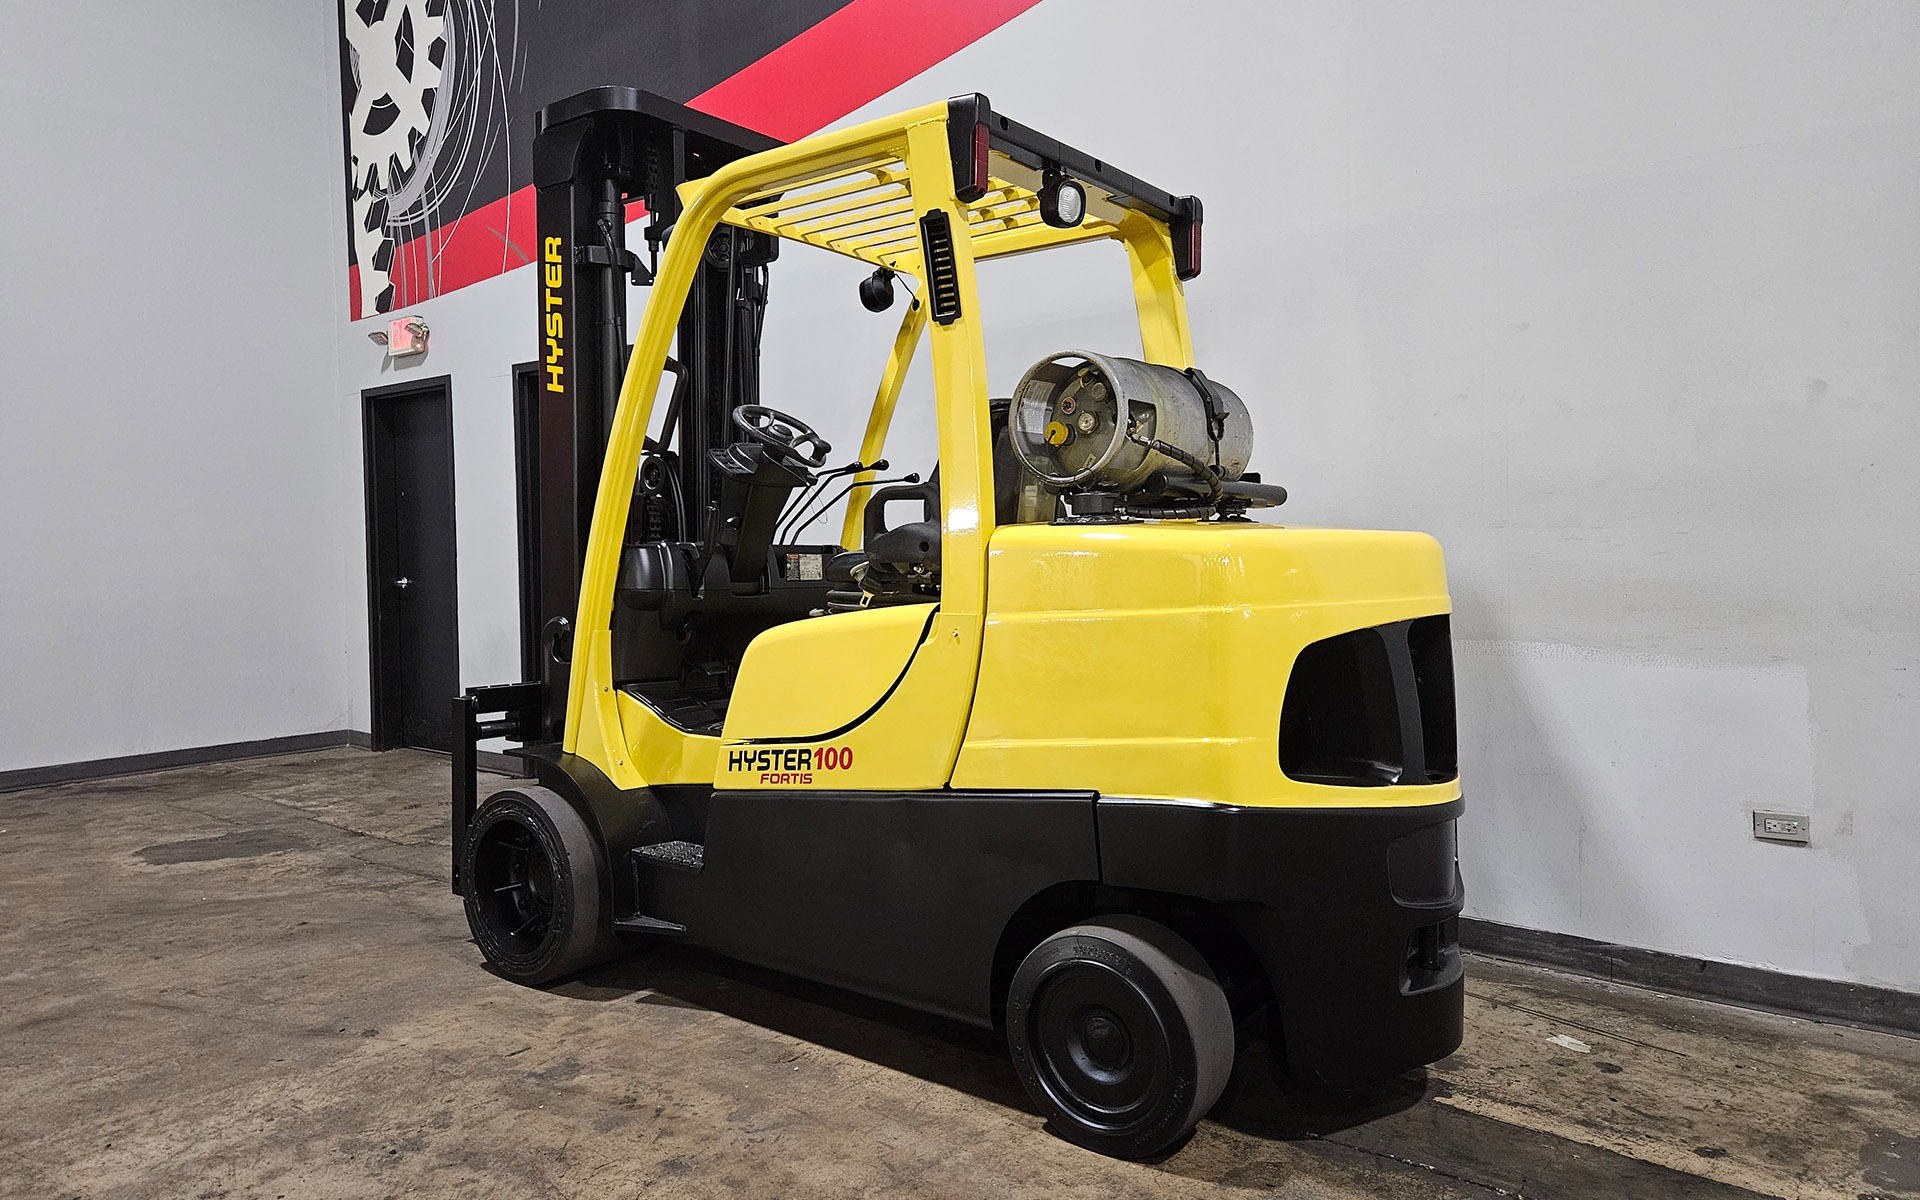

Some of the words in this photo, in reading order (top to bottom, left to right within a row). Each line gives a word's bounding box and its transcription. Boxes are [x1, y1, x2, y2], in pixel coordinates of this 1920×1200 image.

[545, 237, 564, 393] HYSTER
[729, 749, 812, 771] HYSTER
[814, 747, 853, 770] 100
[760, 773, 813, 784] FORTIS
